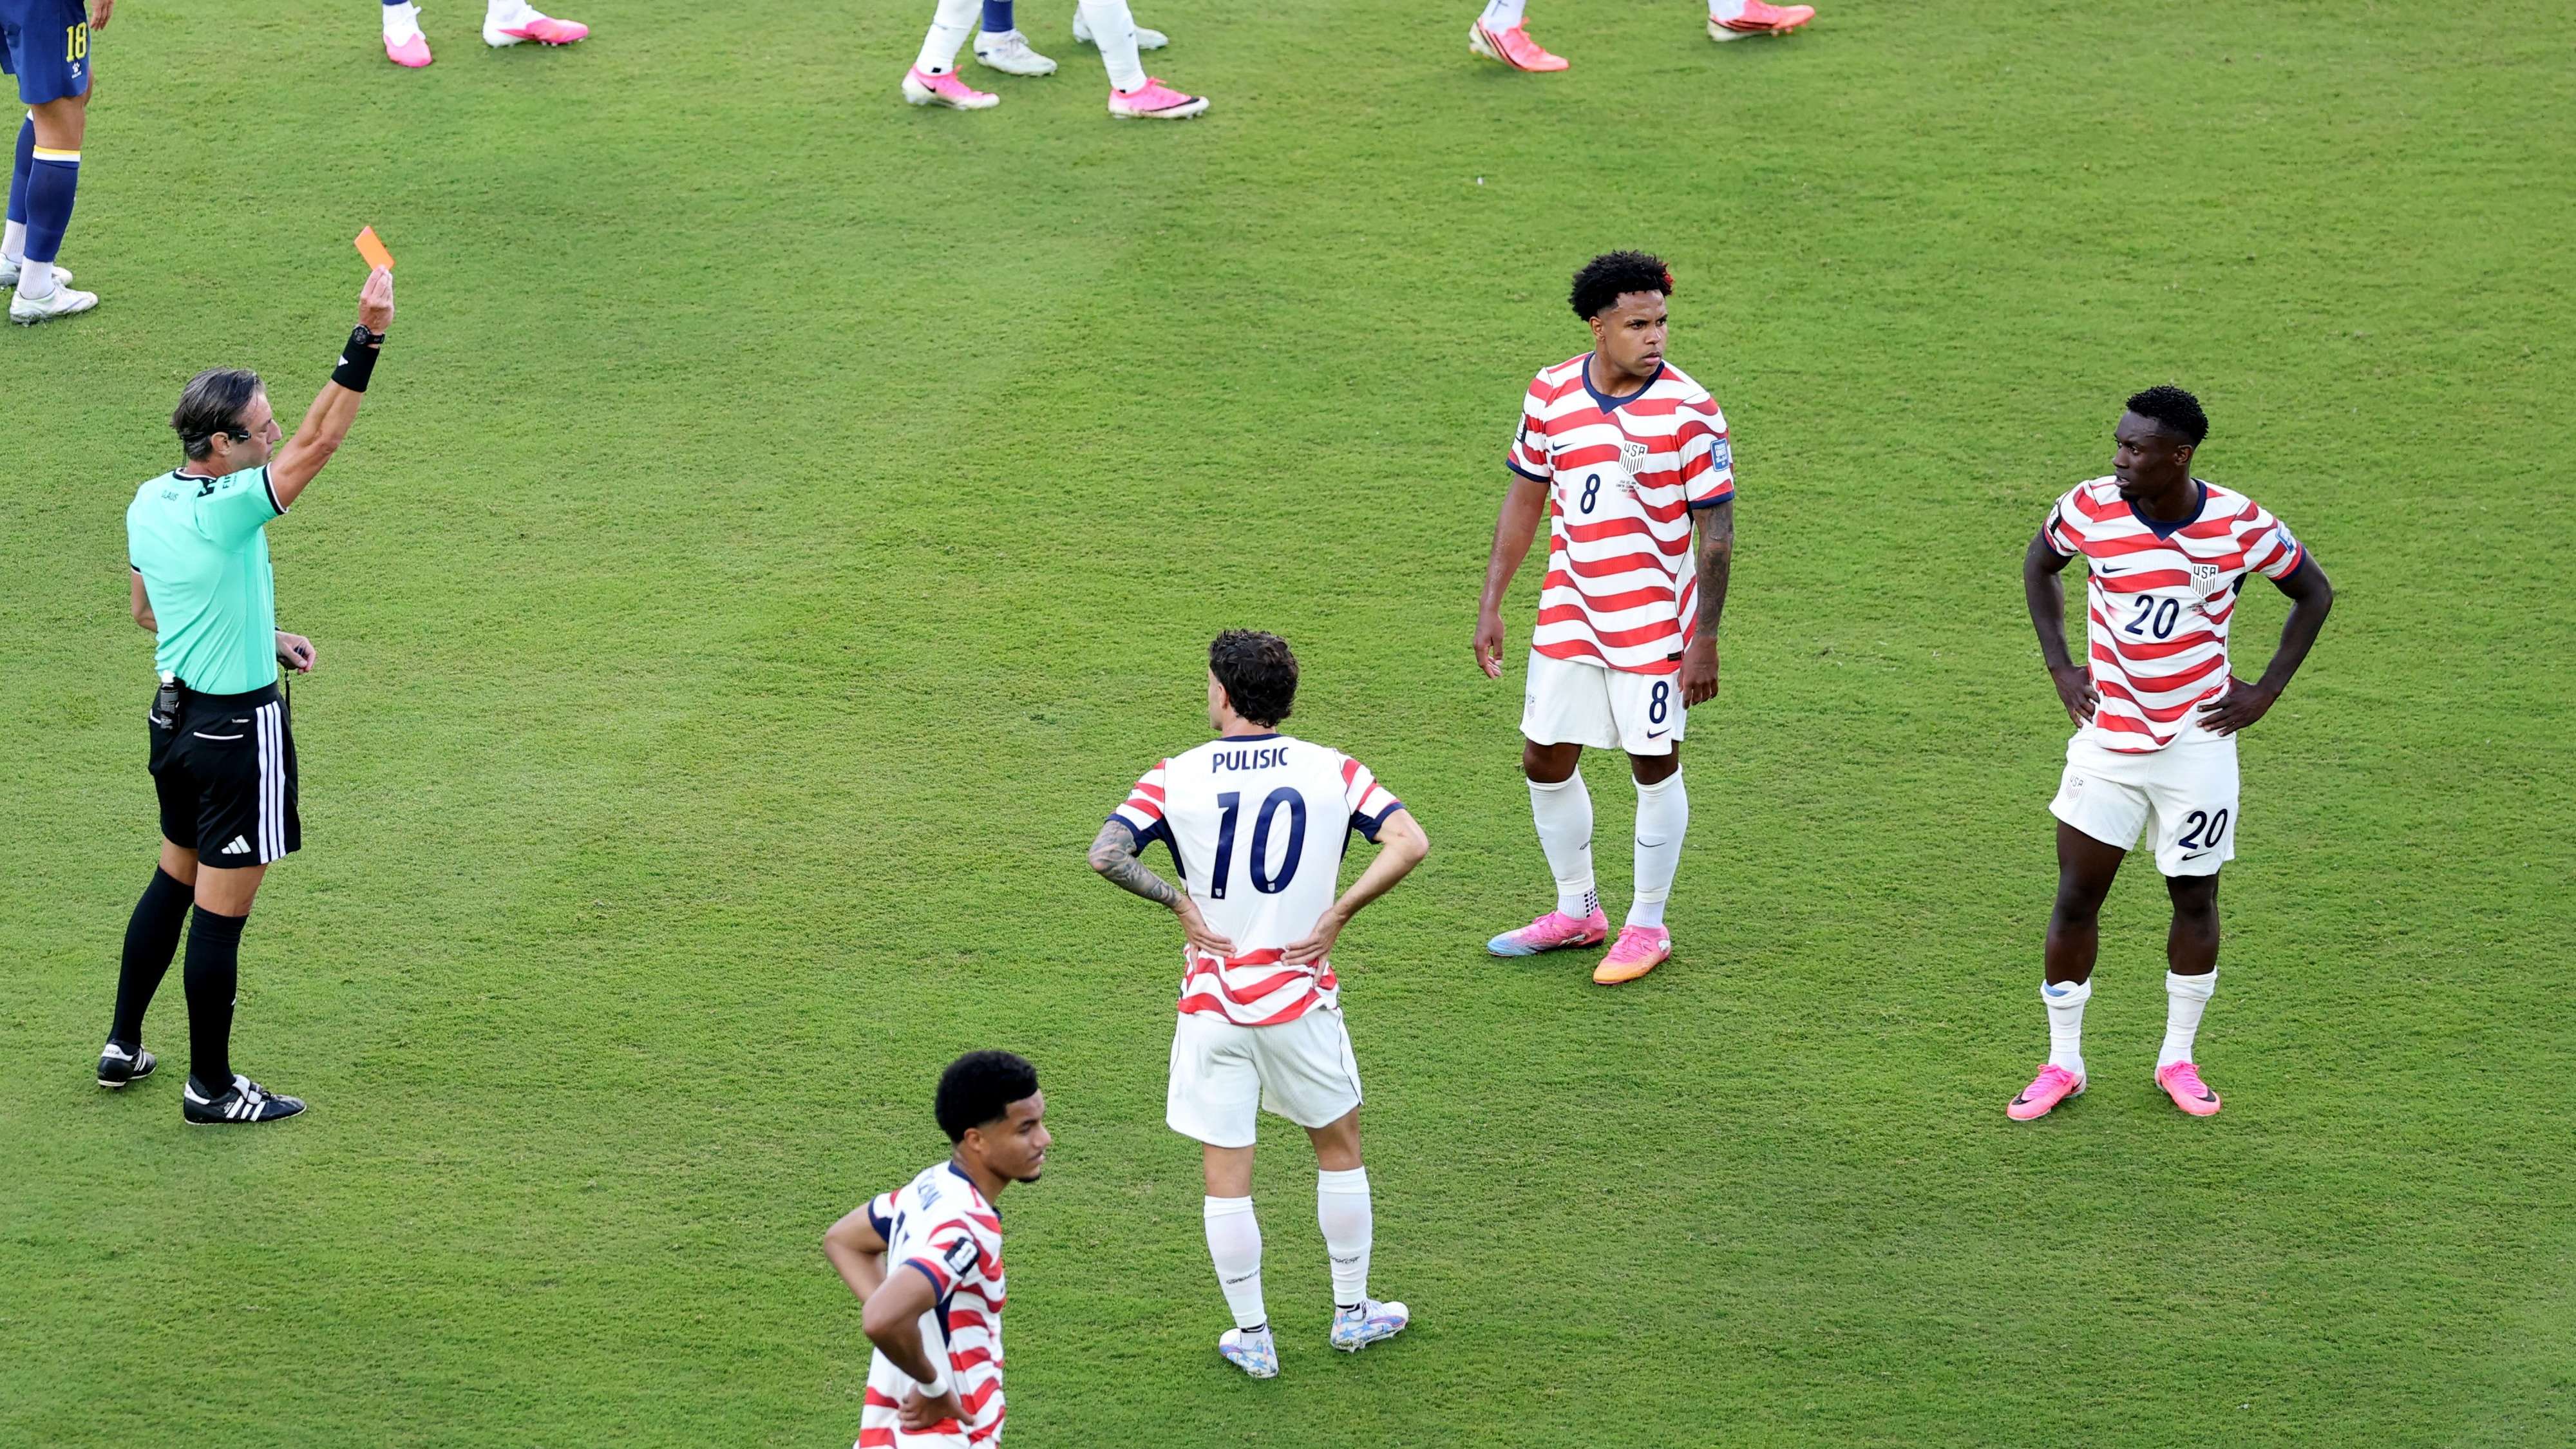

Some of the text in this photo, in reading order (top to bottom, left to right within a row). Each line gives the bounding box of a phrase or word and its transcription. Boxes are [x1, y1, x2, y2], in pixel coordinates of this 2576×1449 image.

[66, 22, 87, 62] 18
[1624, 442, 1645, 457] USA
[222, 475, 231, 489] FIF
[1580, 473, 1600, 514] 8
[2193, 565, 2216, 579] USA
[2125, 594, 2179, 639] 20
[1649, 681, 1669, 724] 8
[1212, 747, 1289, 773] PULISIC
[1211, 786, 1307, 900] 10
[2178, 808, 2228, 850] 20
